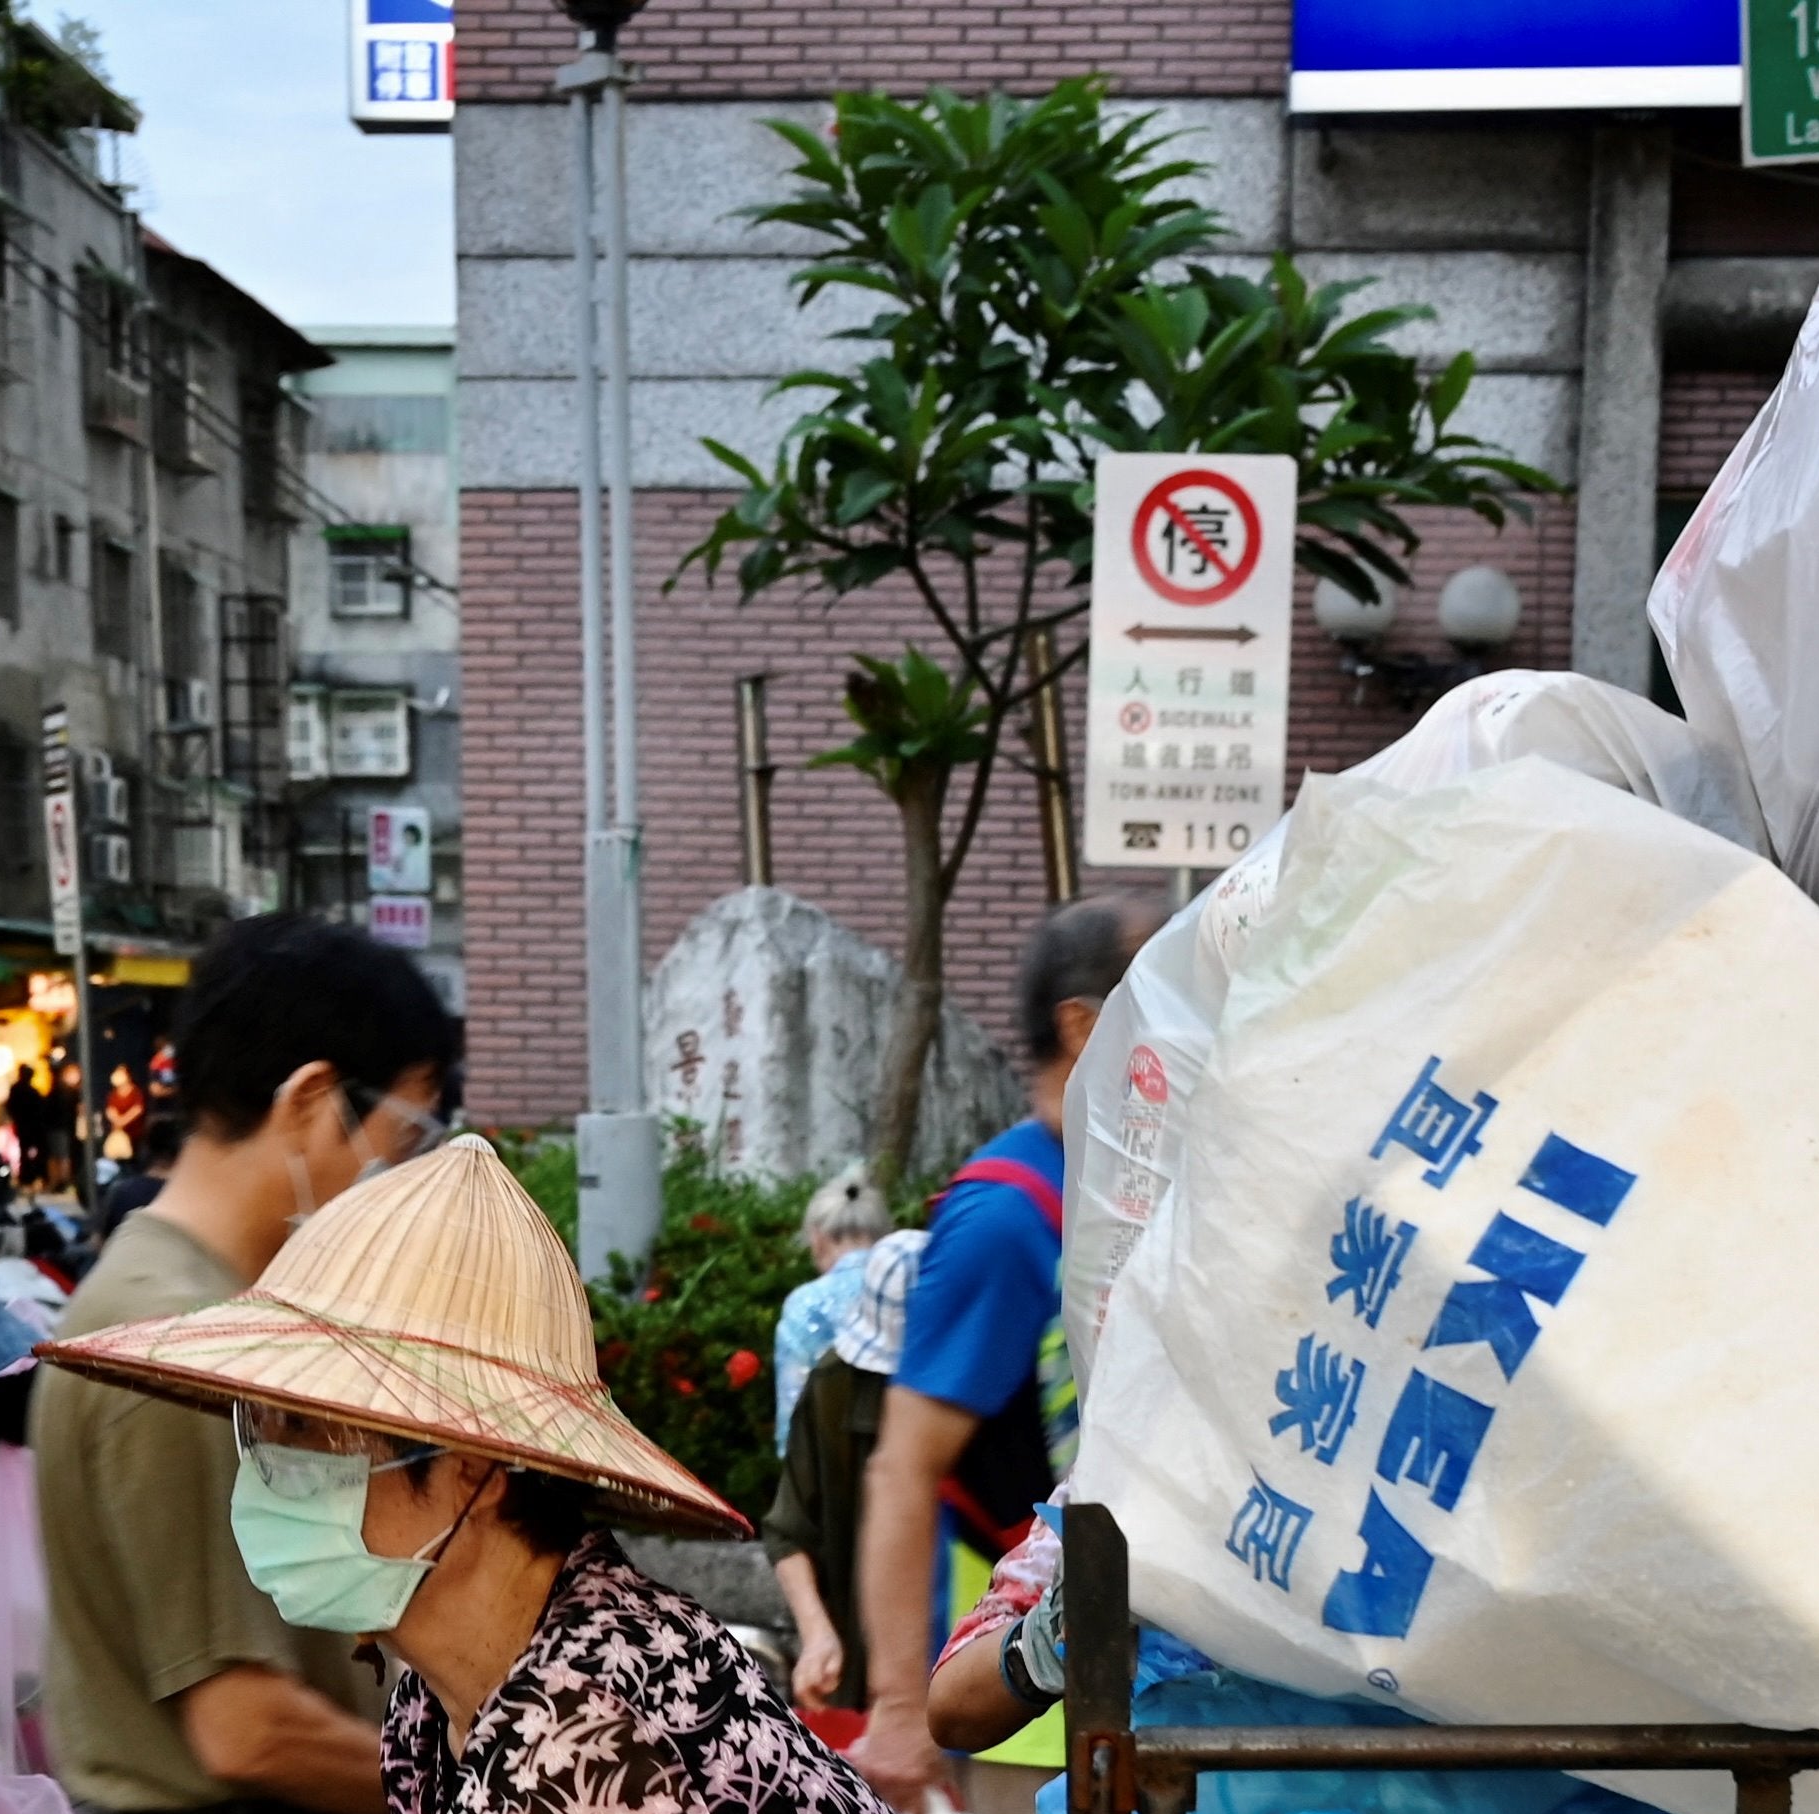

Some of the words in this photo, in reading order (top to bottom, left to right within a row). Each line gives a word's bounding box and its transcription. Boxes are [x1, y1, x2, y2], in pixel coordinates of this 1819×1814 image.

[1161, 503, 1230, 575] 停
[1158, 710, 1253, 729] SIDEWALK
[1213, 784, 1262, 804] ZONE
[1185, 822, 1250, 851] 110
[1225, 1054, 1501, 1594] 宜家家居
[1323, 1130, 1639, 1641] IKEA
